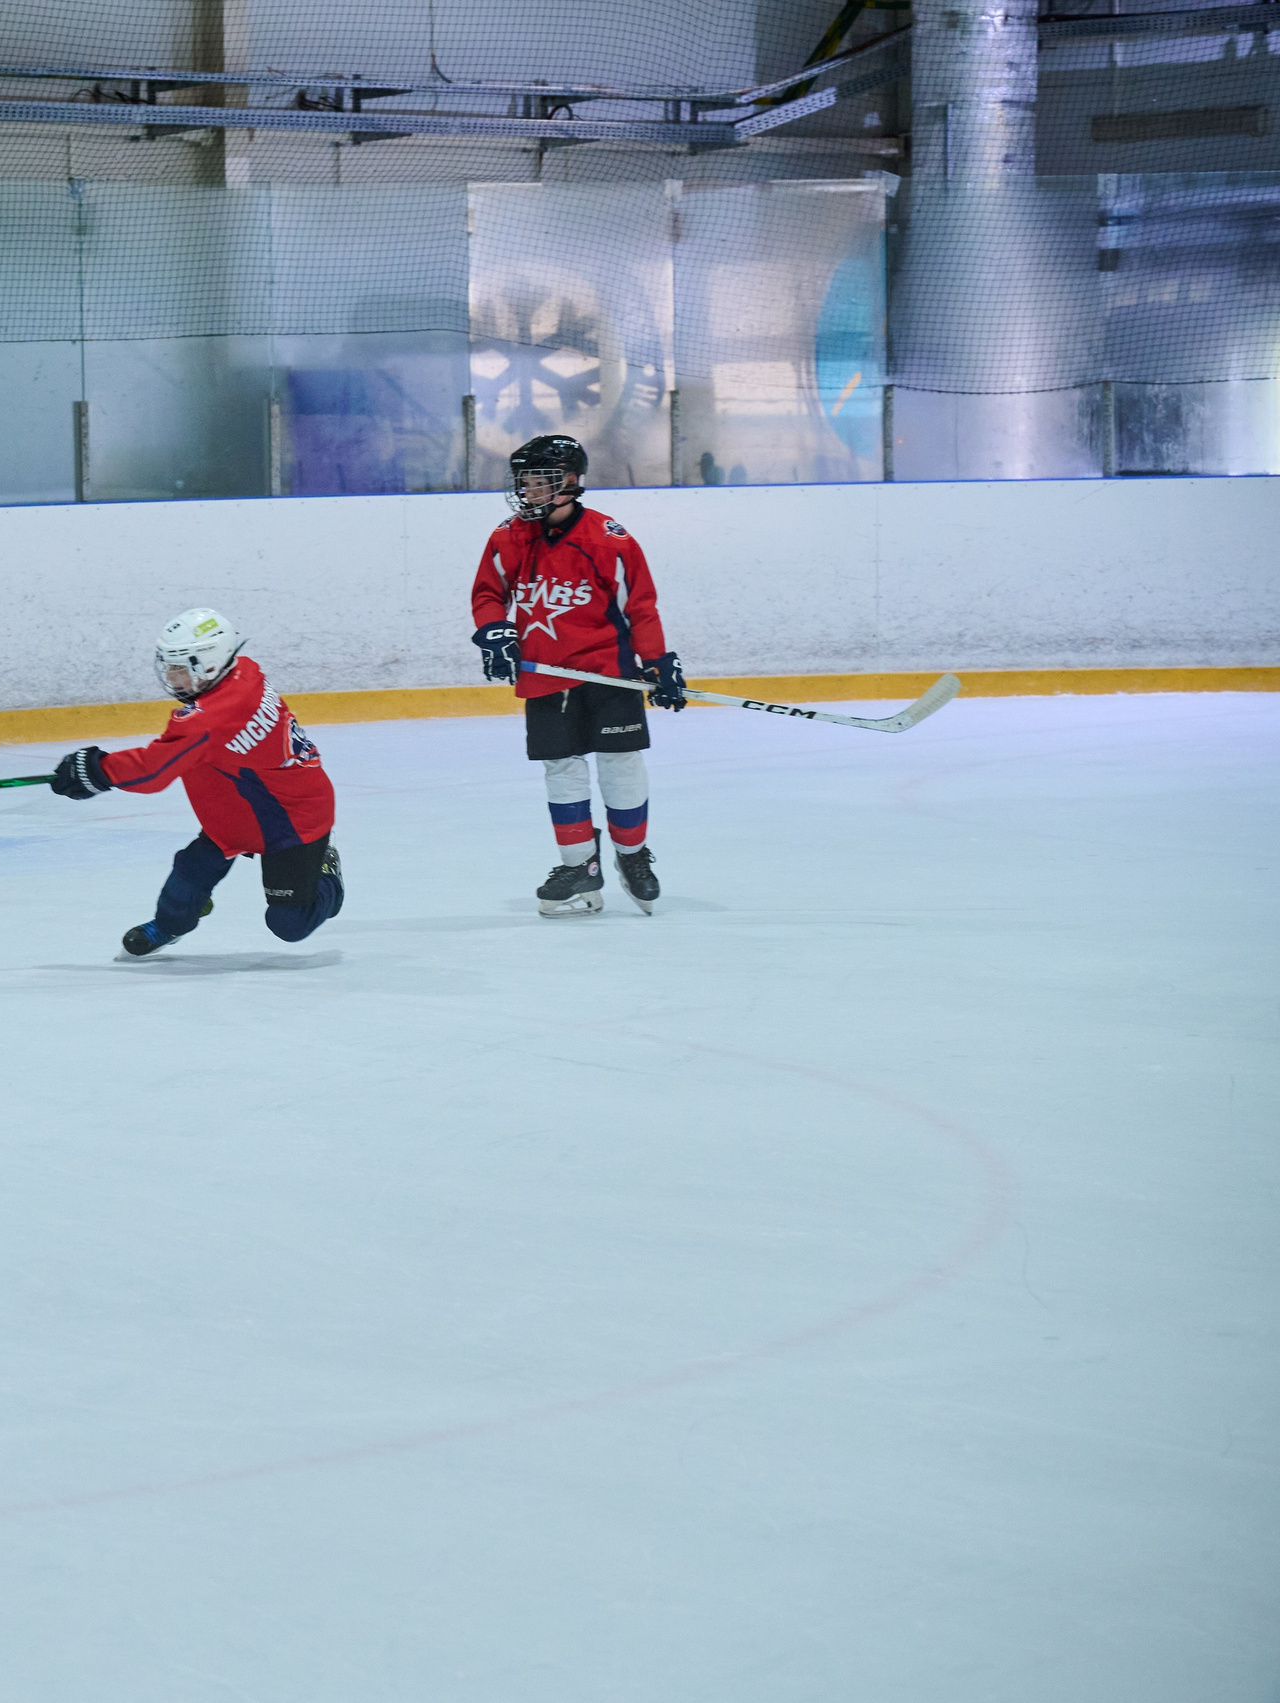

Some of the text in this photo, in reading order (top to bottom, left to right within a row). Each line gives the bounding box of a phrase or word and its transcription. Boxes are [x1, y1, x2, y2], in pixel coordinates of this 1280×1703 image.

[515, 579, 593, 606] STARS
[741, 700, 817, 719] CCM
[601, 723, 643, 735] BAUER
